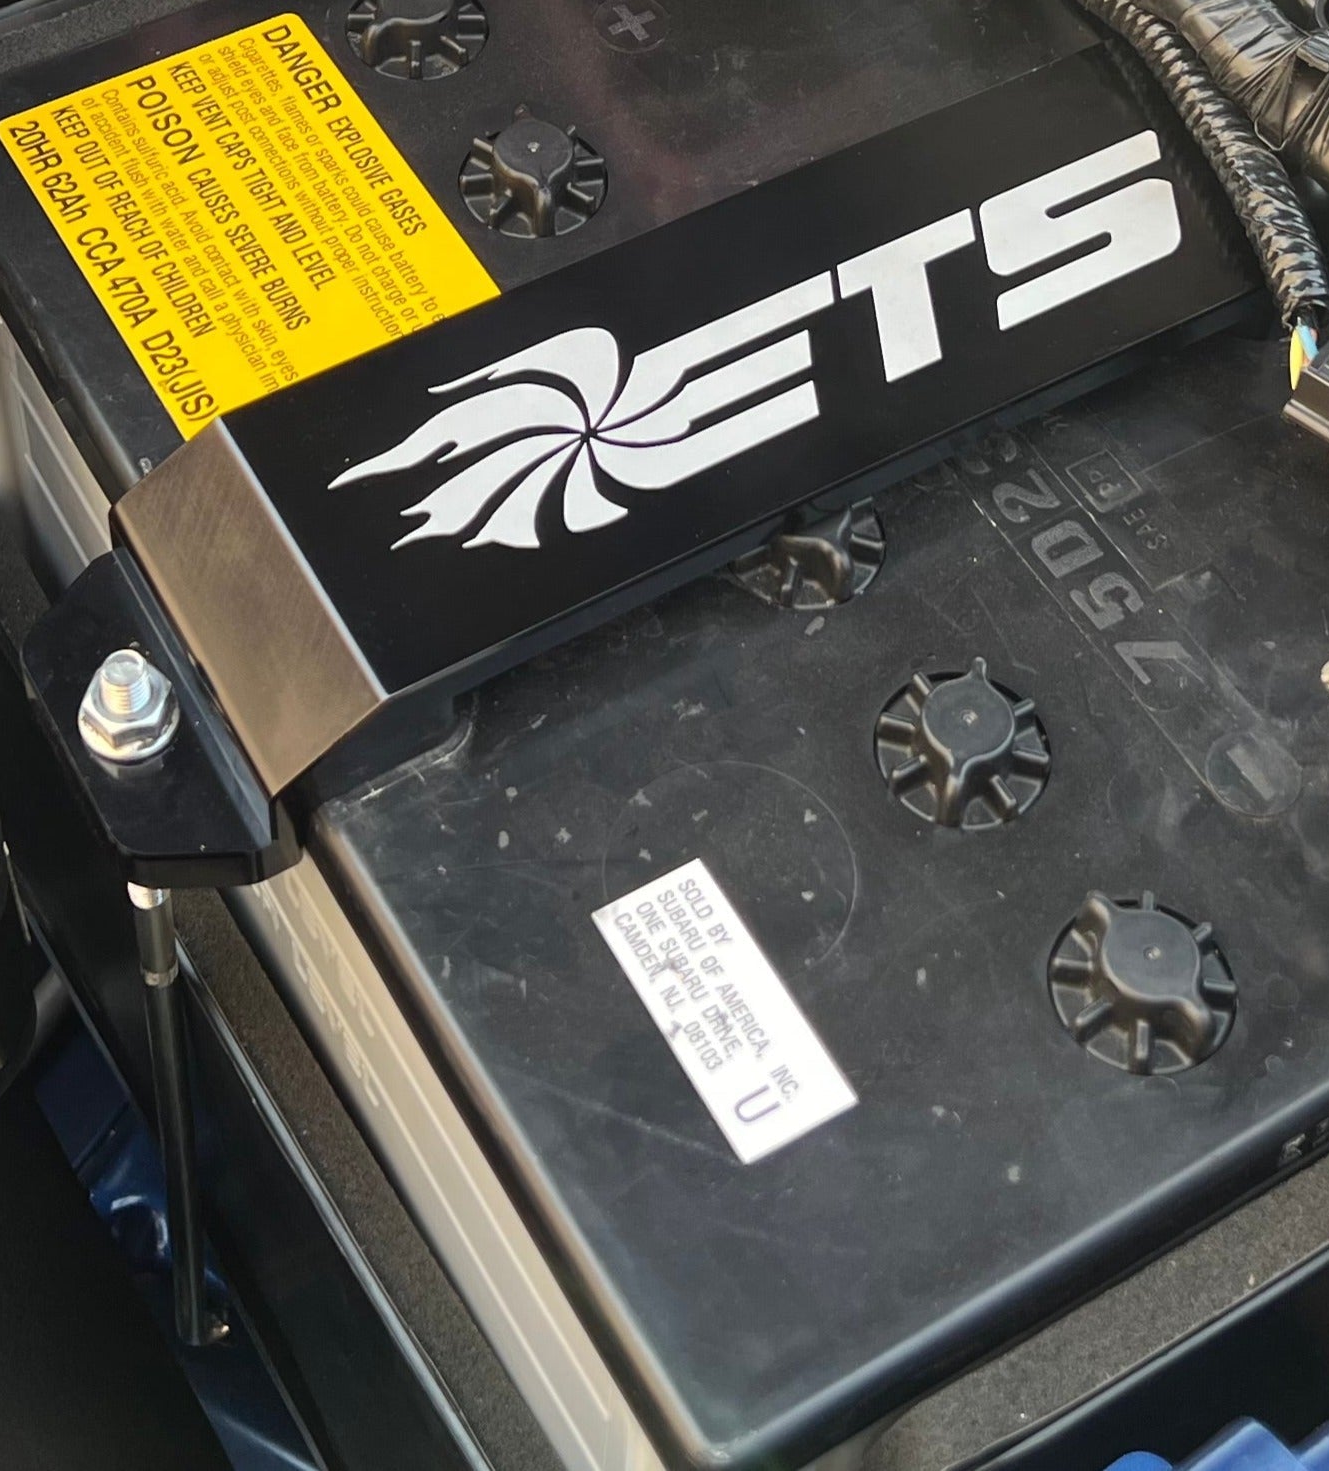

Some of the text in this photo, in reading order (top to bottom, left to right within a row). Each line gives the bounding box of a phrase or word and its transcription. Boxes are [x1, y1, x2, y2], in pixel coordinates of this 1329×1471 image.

[197, 53, 214, 67] or
[216, 44, 251, 79] shield
[234, 36, 289, 97] Cigarettes,
[203, 65, 241, 101] adjust
[236, 78, 266, 106] eyes
[80, 95, 101, 111] of
[227, 99, 256, 126] post
[258, 103, 284, 127] and
[277, 95, 315, 135] flames
[89, 110, 131, 158] accident
[260, 23, 427, 237] DANGER EXPLOSIVE GASES
[273, 126, 302, 153] face
[304, 133, 322, 149] or
[119, 157, 151, 189] flush
[166, 60, 339, 291] KEEP VENT CAPS TIGHT AND LEVEL
[247, 123, 303, 190] connections
[291, 151, 322, 182] from
[311, 146, 352, 187] sparks
[124, 74, 312, 331] POISON CAUSES SEVERE BURNS
[139, 186, 170, 217] with
[291, 188, 334, 236] without
[340, 184, 374, 218] could
[50, 104, 217, 339] KEEP OUT OF REACH OF CHILDREN
[99, 88, 143, 138] Contains
[130, 135, 171, 181] sulfuric
[177, 207, 213, 245] Avoid
[200, 242, 242, 289] contact
[230, 287, 262, 319] with
[247, 317, 283, 352] skin,
[266, 349, 299, 383] eyes
[157, 215, 193, 253] water
[342, 224, 366, 245] Do
[362, 217, 395, 252] cause
[7, 118, 221, 424] 20HR 62Ah CCA 470A D23(JIS)
[182, 252, 210, 278] and
[320, 235, 358, 277] proper
[355, 242, 380, 265] not
[196, 275, 224, 301] call
[367, 263, 410, 308] charge
[384, 250, 430, 299] battery
[399, 306, 418, 323] or
[419, 296, 440, 313] to
[591, 128, 1183, 490] ETS
[216, 310, 271, 374] physician
[676, 877, 732, 948] SOLD BY
[611, 910, 668, 983] CAMDEN,
[680, 1019, 724, 1073] 08103
[634, 899, 744, 1059] ONE SUBARU DRIVE,
[655, 888, 803, 1102] SUBARU OF AMERICA, INC.
